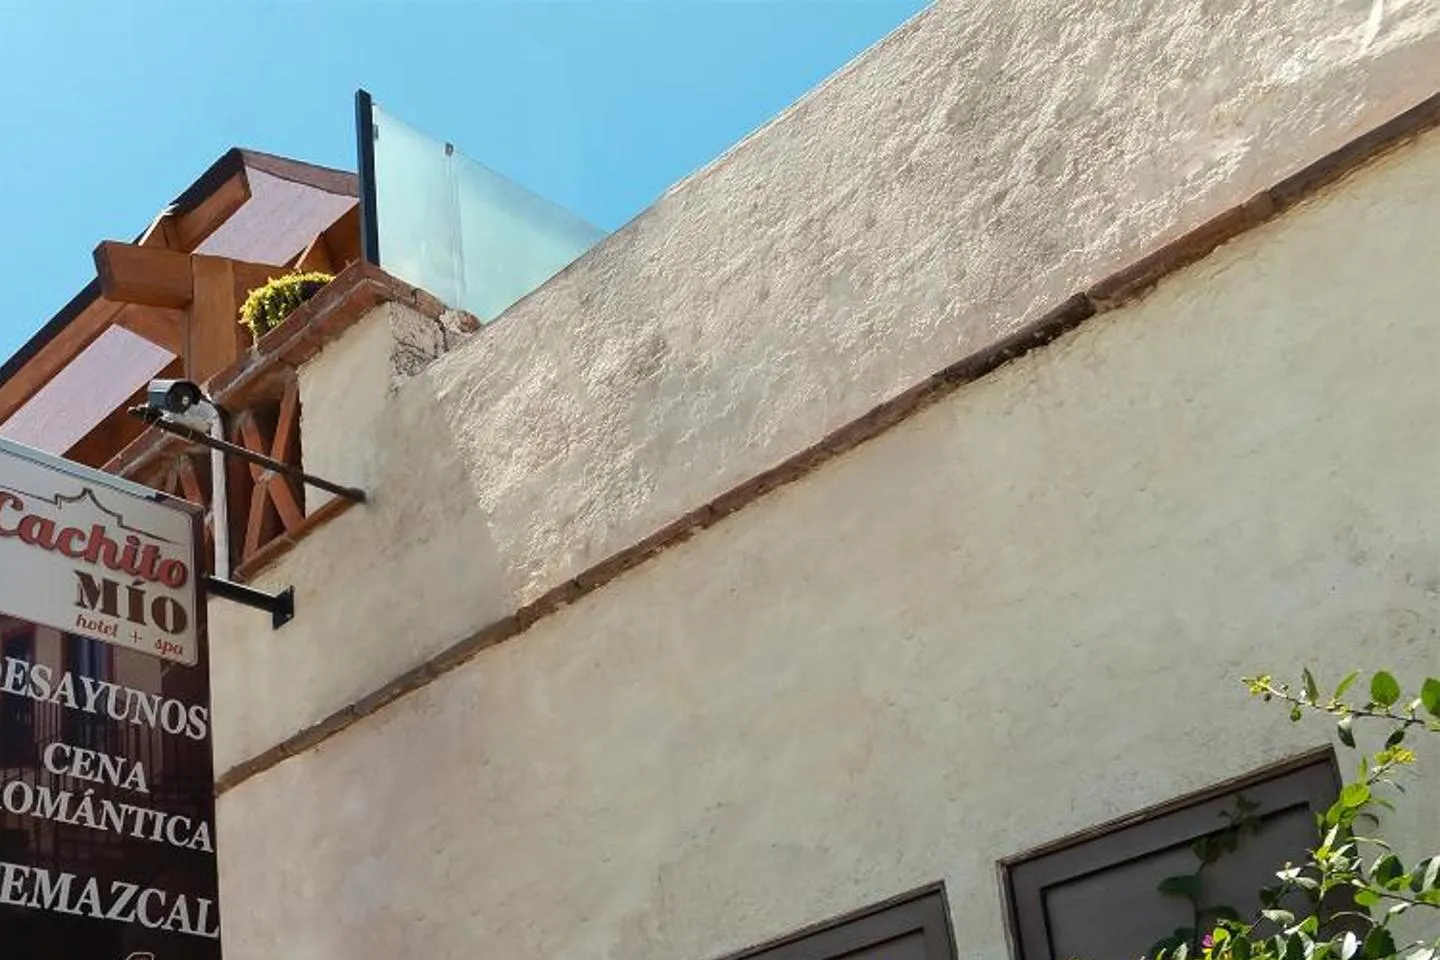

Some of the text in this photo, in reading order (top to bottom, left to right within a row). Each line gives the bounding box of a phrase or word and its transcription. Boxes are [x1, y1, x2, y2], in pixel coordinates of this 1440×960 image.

[73, 570, 188, 635] MÍO
[76, 613, 119, 638] hotel
[155, 638, 184, 656] spa
[43, 742, 150, 793] CENA
